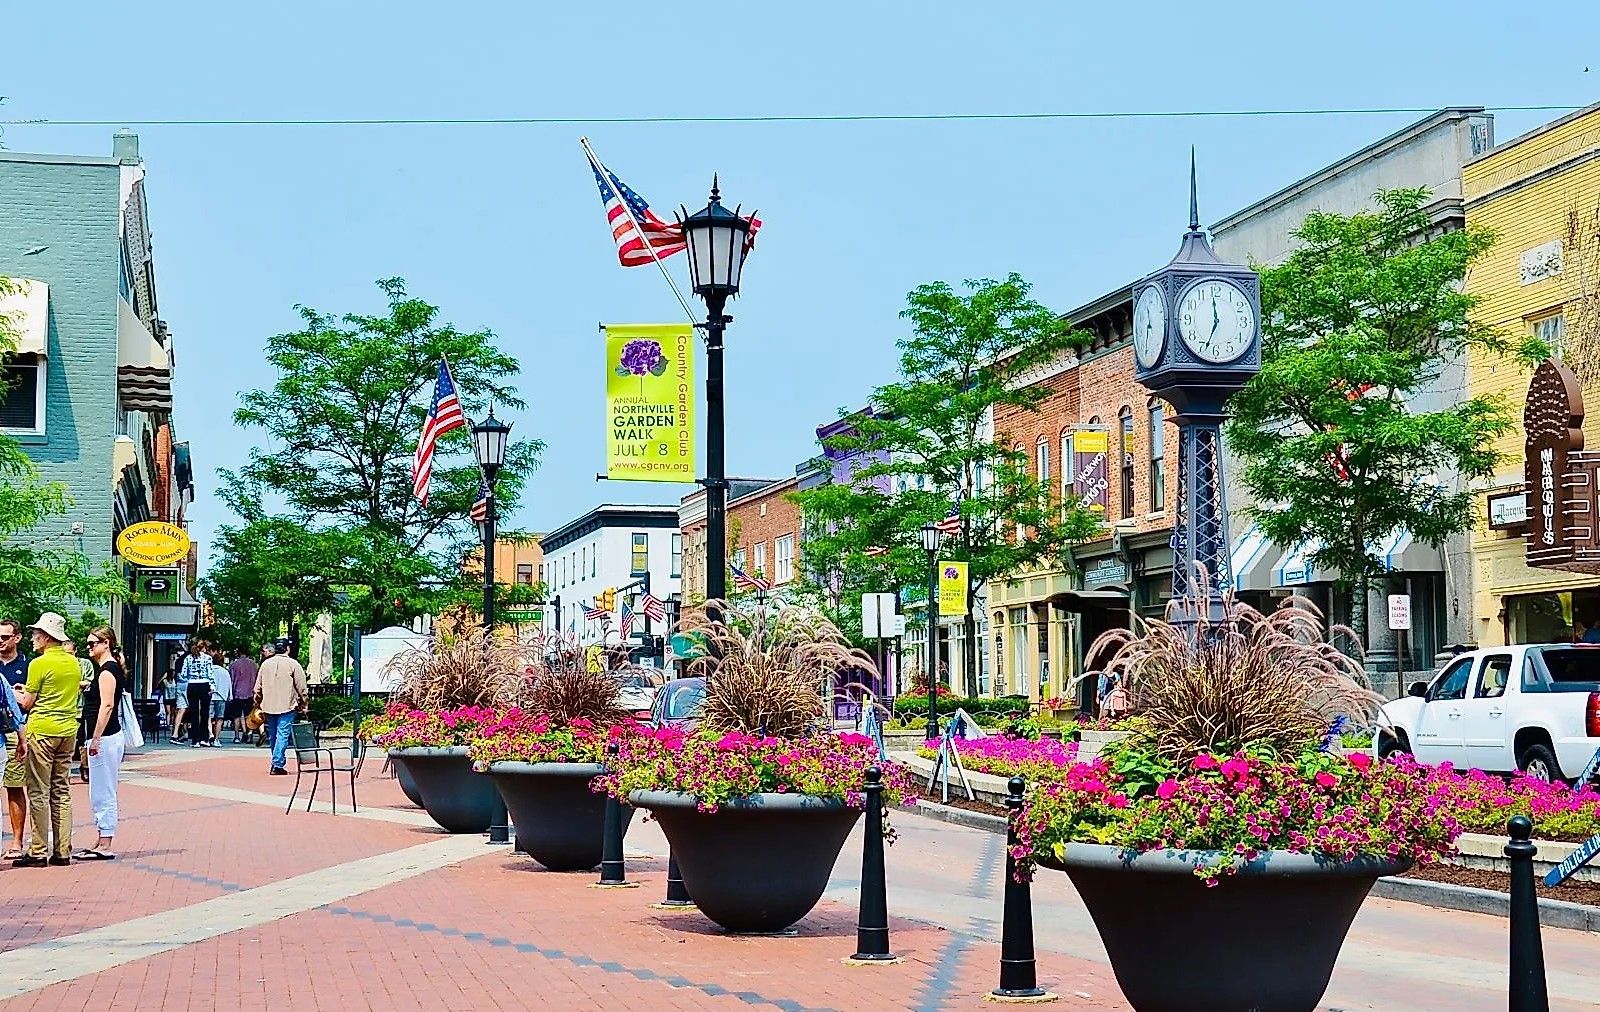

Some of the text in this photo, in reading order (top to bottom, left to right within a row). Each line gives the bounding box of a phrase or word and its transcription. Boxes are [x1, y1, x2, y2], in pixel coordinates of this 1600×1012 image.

[1236, 301, 1244, 313] 2
[1184, 314, 1191, 326] 9
[1240, 317, 1247, 328] 3
[1189, 330, 1196, 340] 8
[1212, 344, 1220, 357] 6
[1226, 341, 1234, 353] 5
[613, 396, 649, 404] ANNUAL
[676, 335, 689, 457] Country Garden Club
[613, 404, 675, 414] NORTHVILLE
[613, 415, 675, 427] GARDEN
[613, 428, 654, 440] WALK
[613, 443, 668, 457] JULY 8
[614, 461, 689, 473] www.cgcnv.org
[1076, 452, 1106, 482] Walkway
[1086, 477, 1096, 486] to
[1076, 477, 1109, 510] Parking
[1540, 447, 1555, 545] MARQUIS
[124, 527, 149, 542] ROCK
[149, 527, 159, 535] ON
[160, 525, 184, 542] MAIN
[124, 546, 183, 563] CLOTHING COMPANY
[150, 579, 166, 590] 5
[1558, 845, 1588, 878] POLICE
